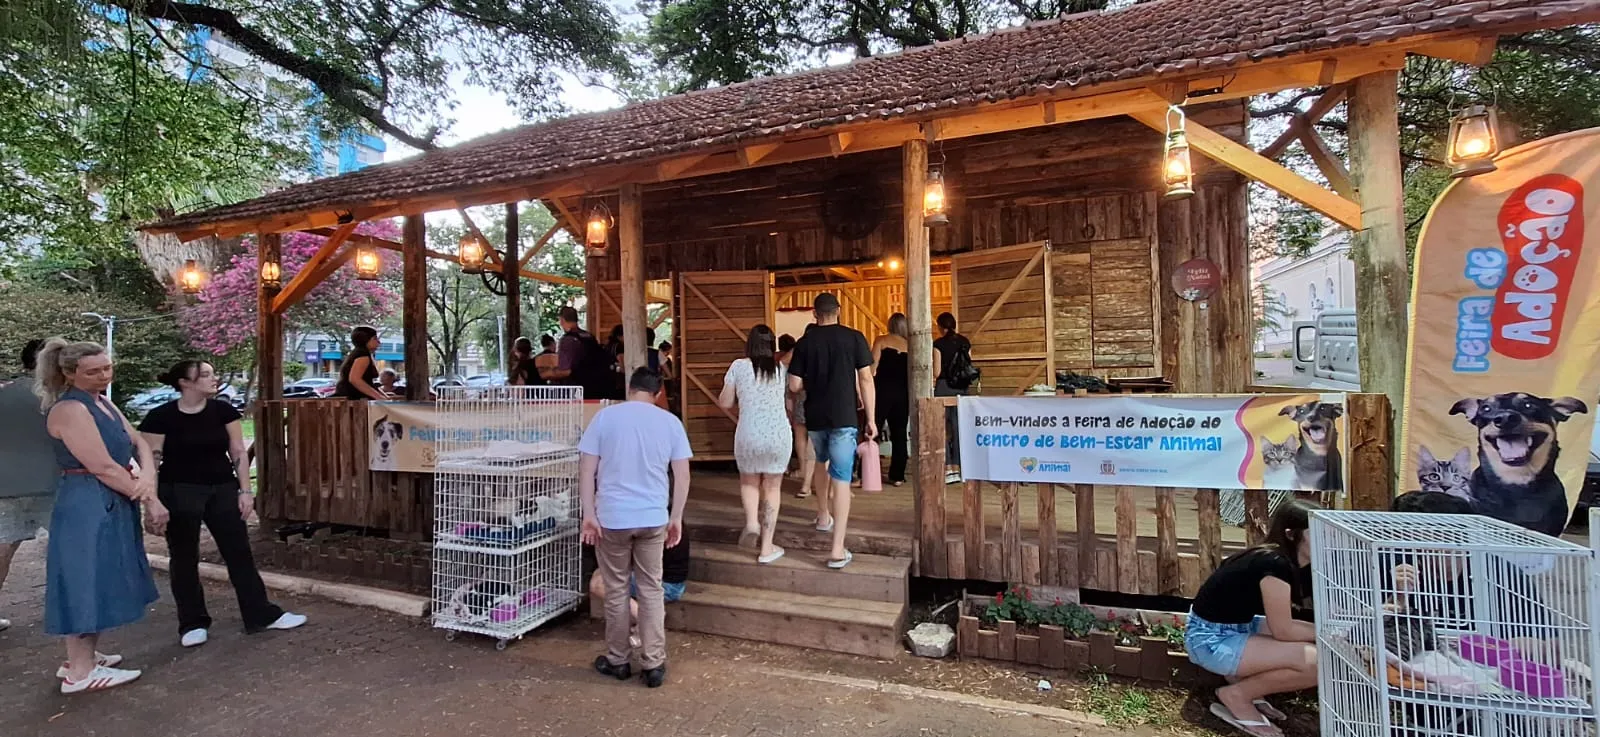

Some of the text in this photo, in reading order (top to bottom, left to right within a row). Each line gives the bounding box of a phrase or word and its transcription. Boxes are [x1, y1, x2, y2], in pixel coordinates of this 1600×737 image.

[1501, 188, 1575, 345] Adoção
[1456, 250, 1503, 368] Feira de
[974, 412, 1222, 431] Bem-Vindos a Feira de Adoção do
[976, 433, 1222, 451] Centro de Bem-Estar Animal
